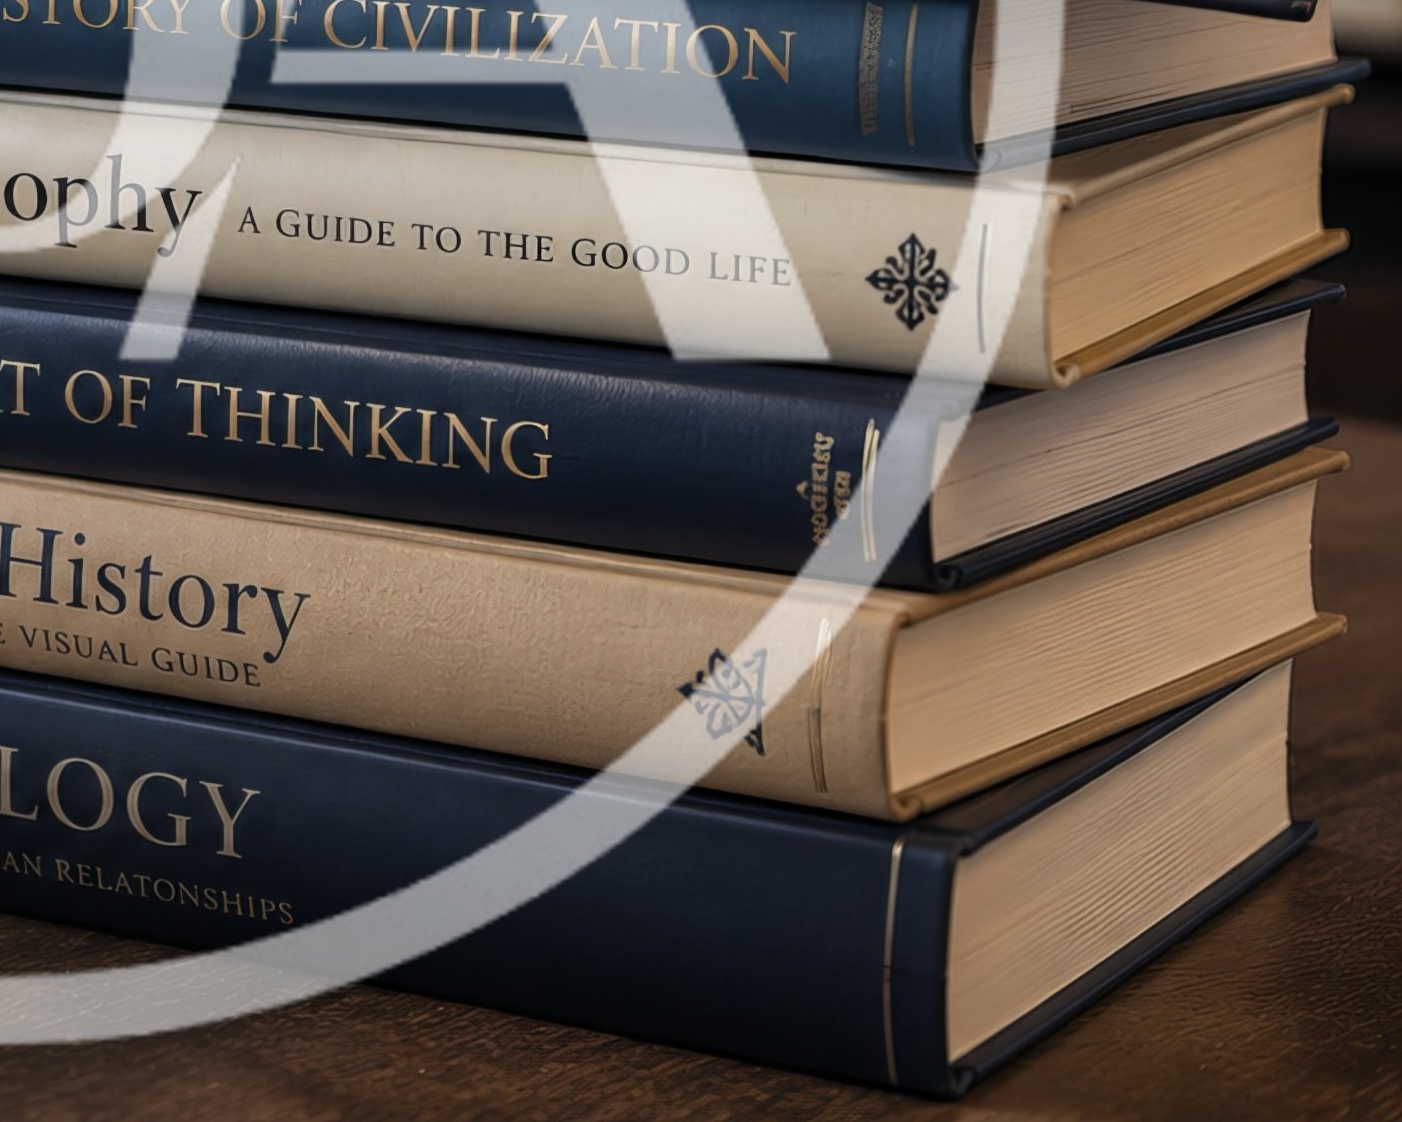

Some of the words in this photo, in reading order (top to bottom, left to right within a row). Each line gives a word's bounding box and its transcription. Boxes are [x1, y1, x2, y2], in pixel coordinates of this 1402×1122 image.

[237, 206, 261, 235] A
[276, 208, 397, 248] GUIDE
[411, 222, 462, 254] TO
[477, 229, 555, 264] THE
[571, 238, 691, 277] GOOD
[708, 250, 792, 287] LIFE
[64, 369, 151, 428] OF
[176, 377, 553, 480] THINKING
[18, 624, 139, 667] VISUAL
[151, 647, 261, 687] GUIDE
[55, 858, 294, 925] RELATONSHIPS
